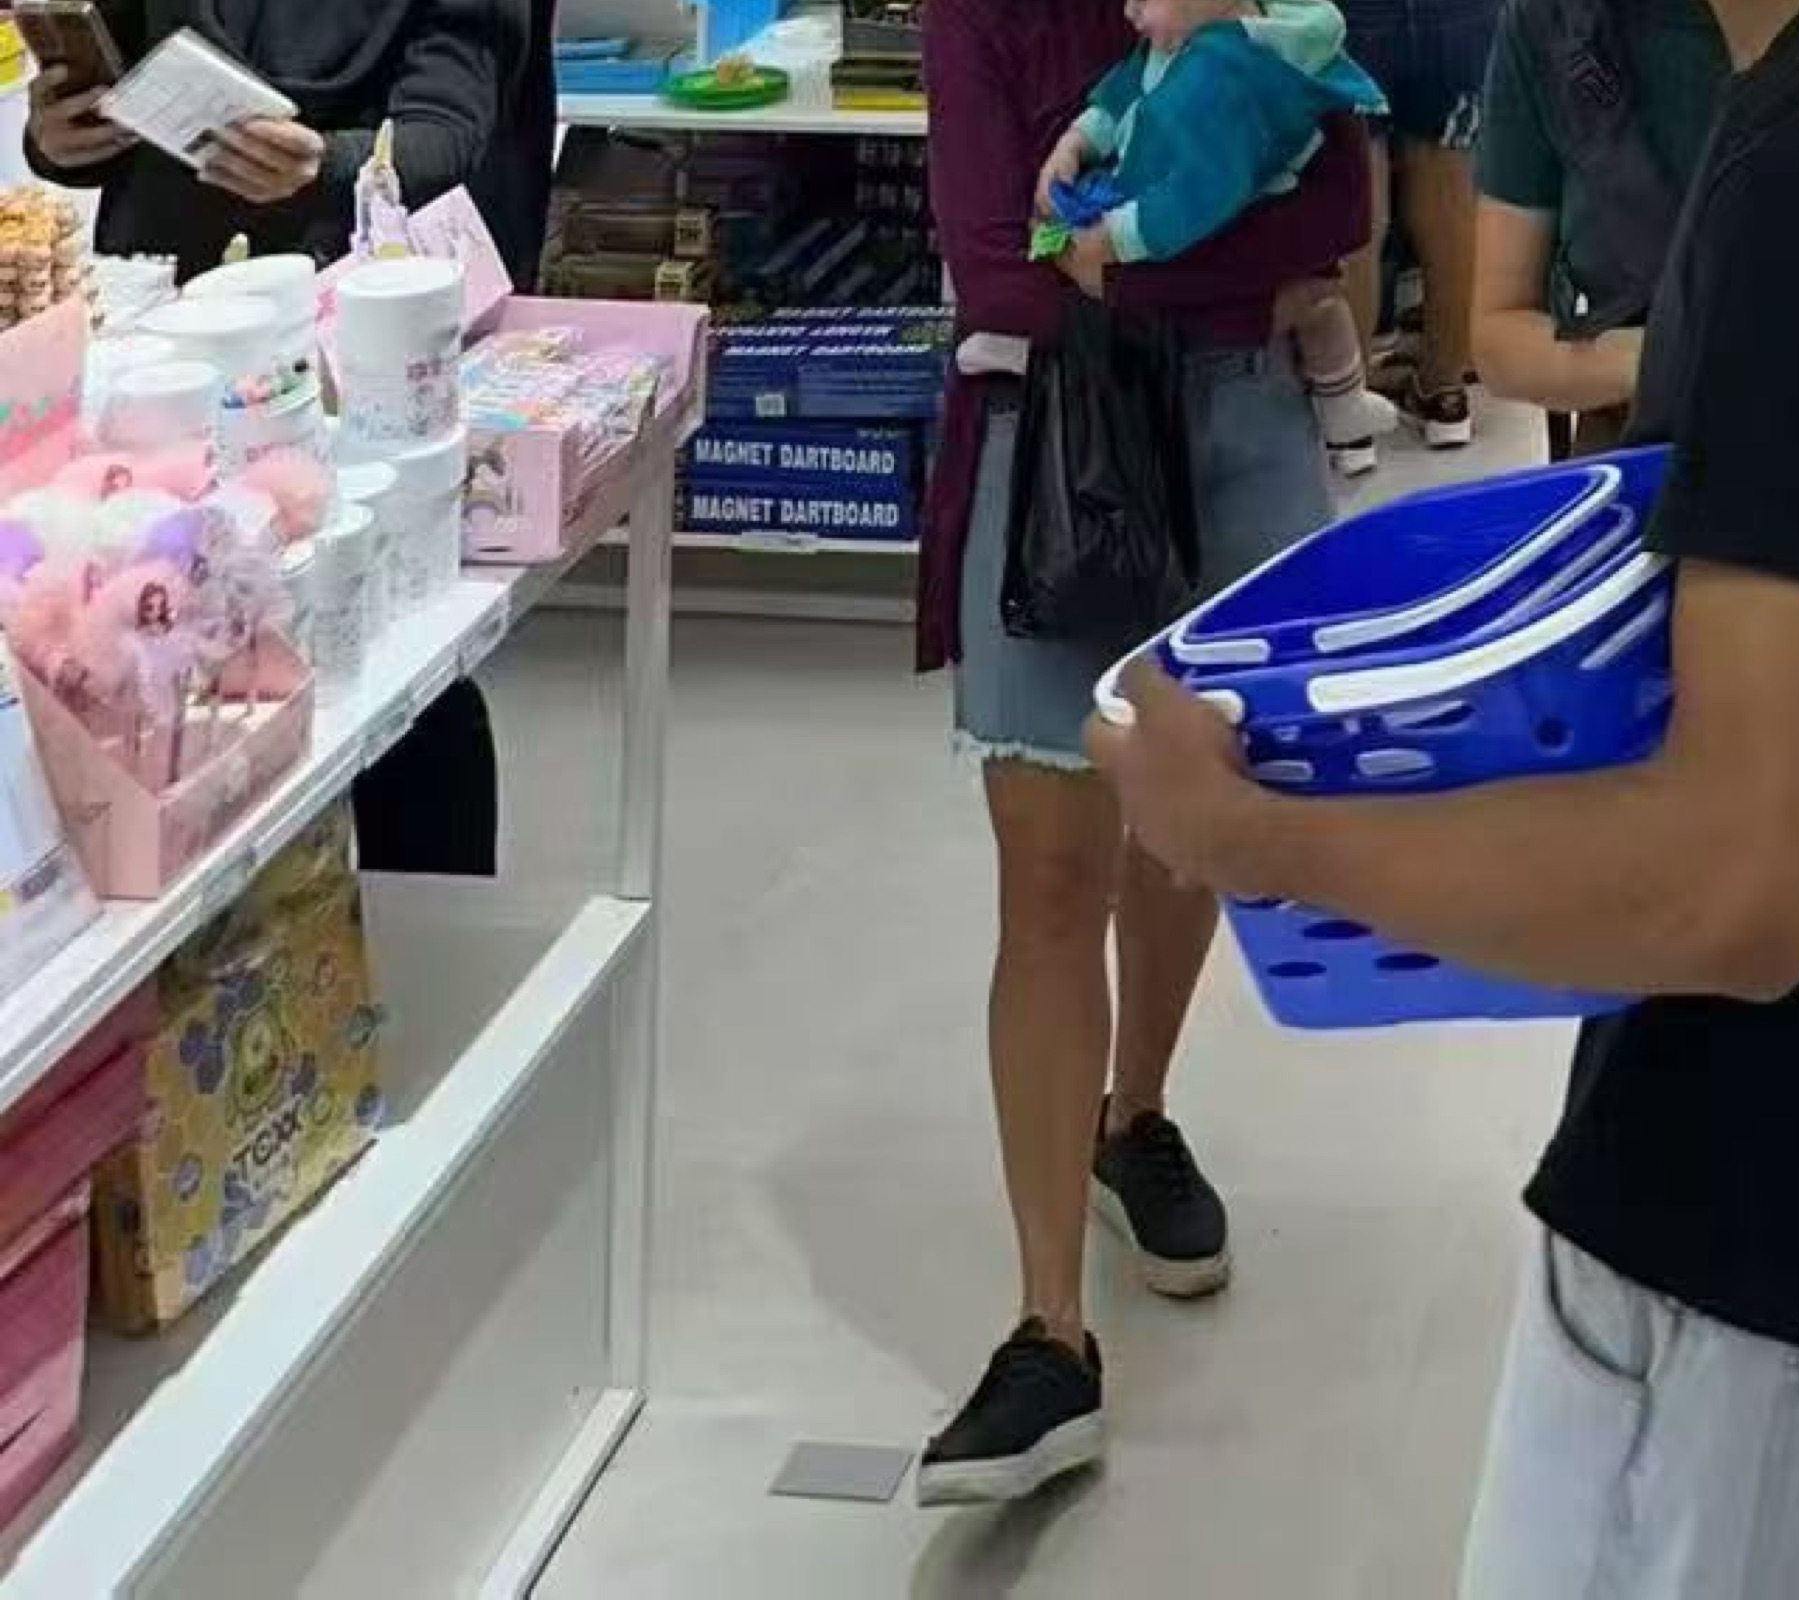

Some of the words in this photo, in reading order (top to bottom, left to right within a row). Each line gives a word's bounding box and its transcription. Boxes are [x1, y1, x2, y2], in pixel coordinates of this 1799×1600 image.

[695, 438, 774, 466] MAGNET
[779, 444, 896, 474] DARTBOARD
[692, 494, 774, 523] MAGNET
[779, 499, 899, 528] DARTBOARD
